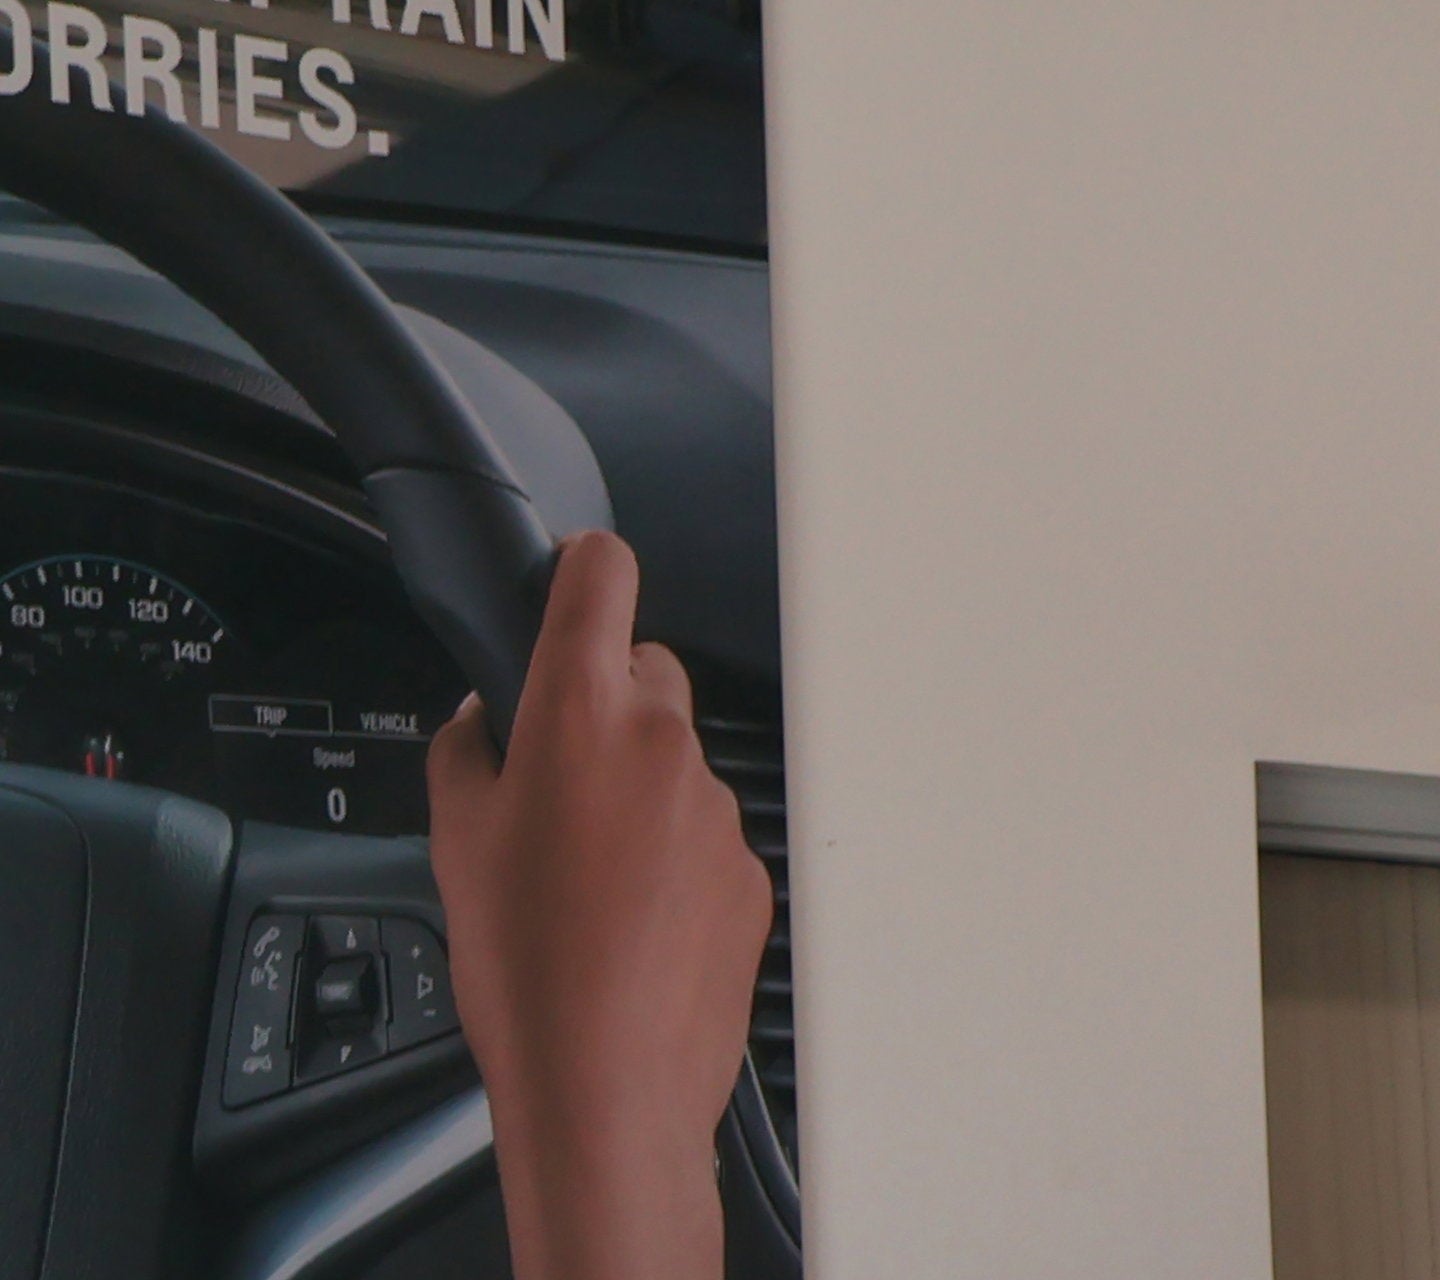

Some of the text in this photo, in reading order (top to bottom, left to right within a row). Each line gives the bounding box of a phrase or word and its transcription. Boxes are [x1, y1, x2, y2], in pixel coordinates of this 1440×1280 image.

[63, 585, 103, 610] 100
[129, 599, 169, 624] 120
[171, 639, 213, 664] 140
[255, 705, 418, 733] TRIP VEHICLE
